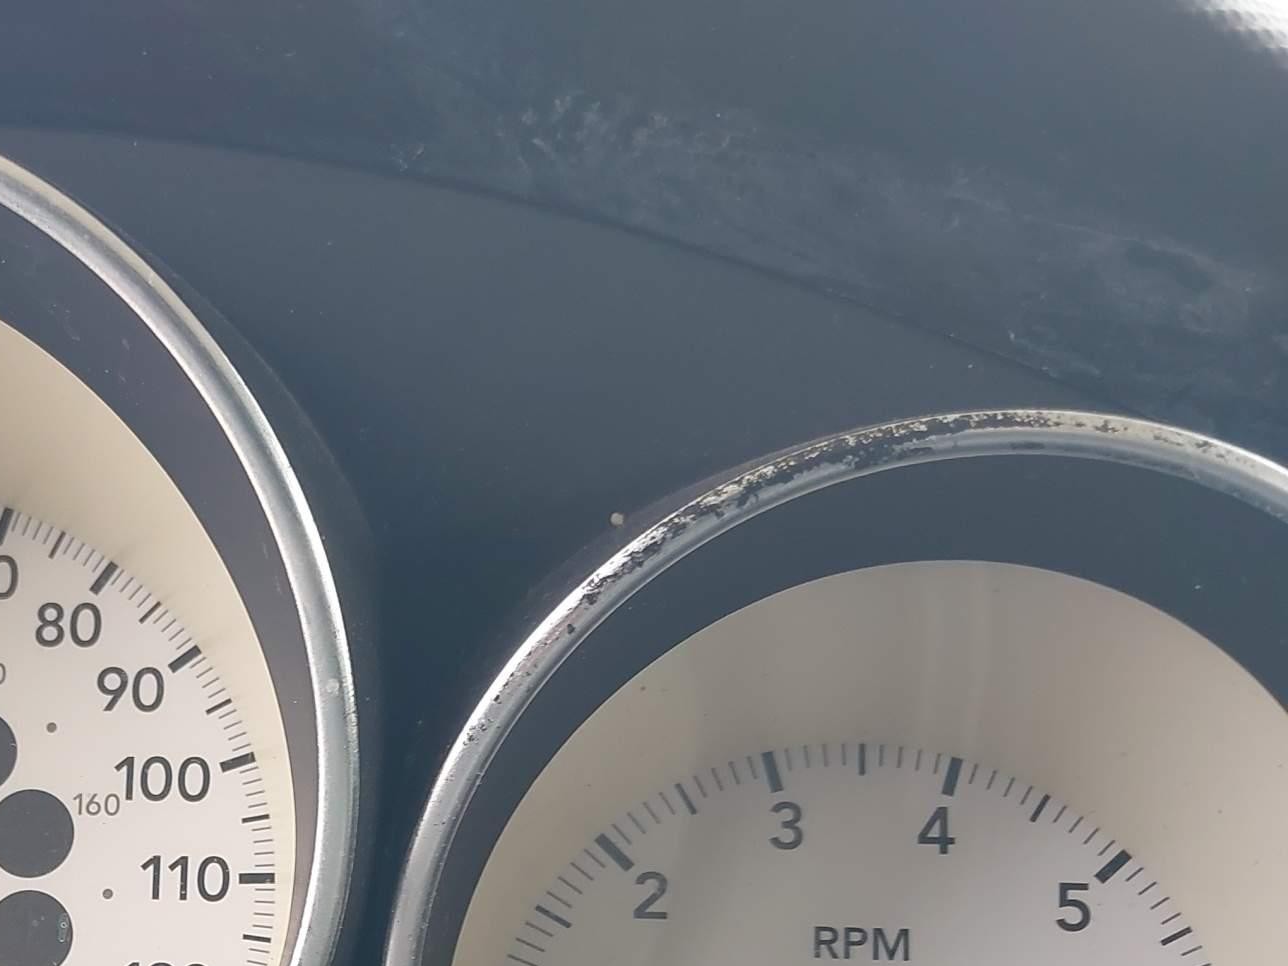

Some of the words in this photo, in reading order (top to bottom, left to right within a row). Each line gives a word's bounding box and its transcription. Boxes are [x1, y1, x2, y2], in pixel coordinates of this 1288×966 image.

[36, 603, 101, 647] 80
[97, 667, 164, 712] 90
[113, 756, 211, 803] 100
[72, 793, 120, 817] 160
[770, 802, 802, 849] 3
[918, 807, 955, 854] 4
[141, 856, 229, 902] 110
[632, 870, 668, 920] 2
[1056, 883, 1090, 931] 5
[815, 927, 909, 961] RPM
